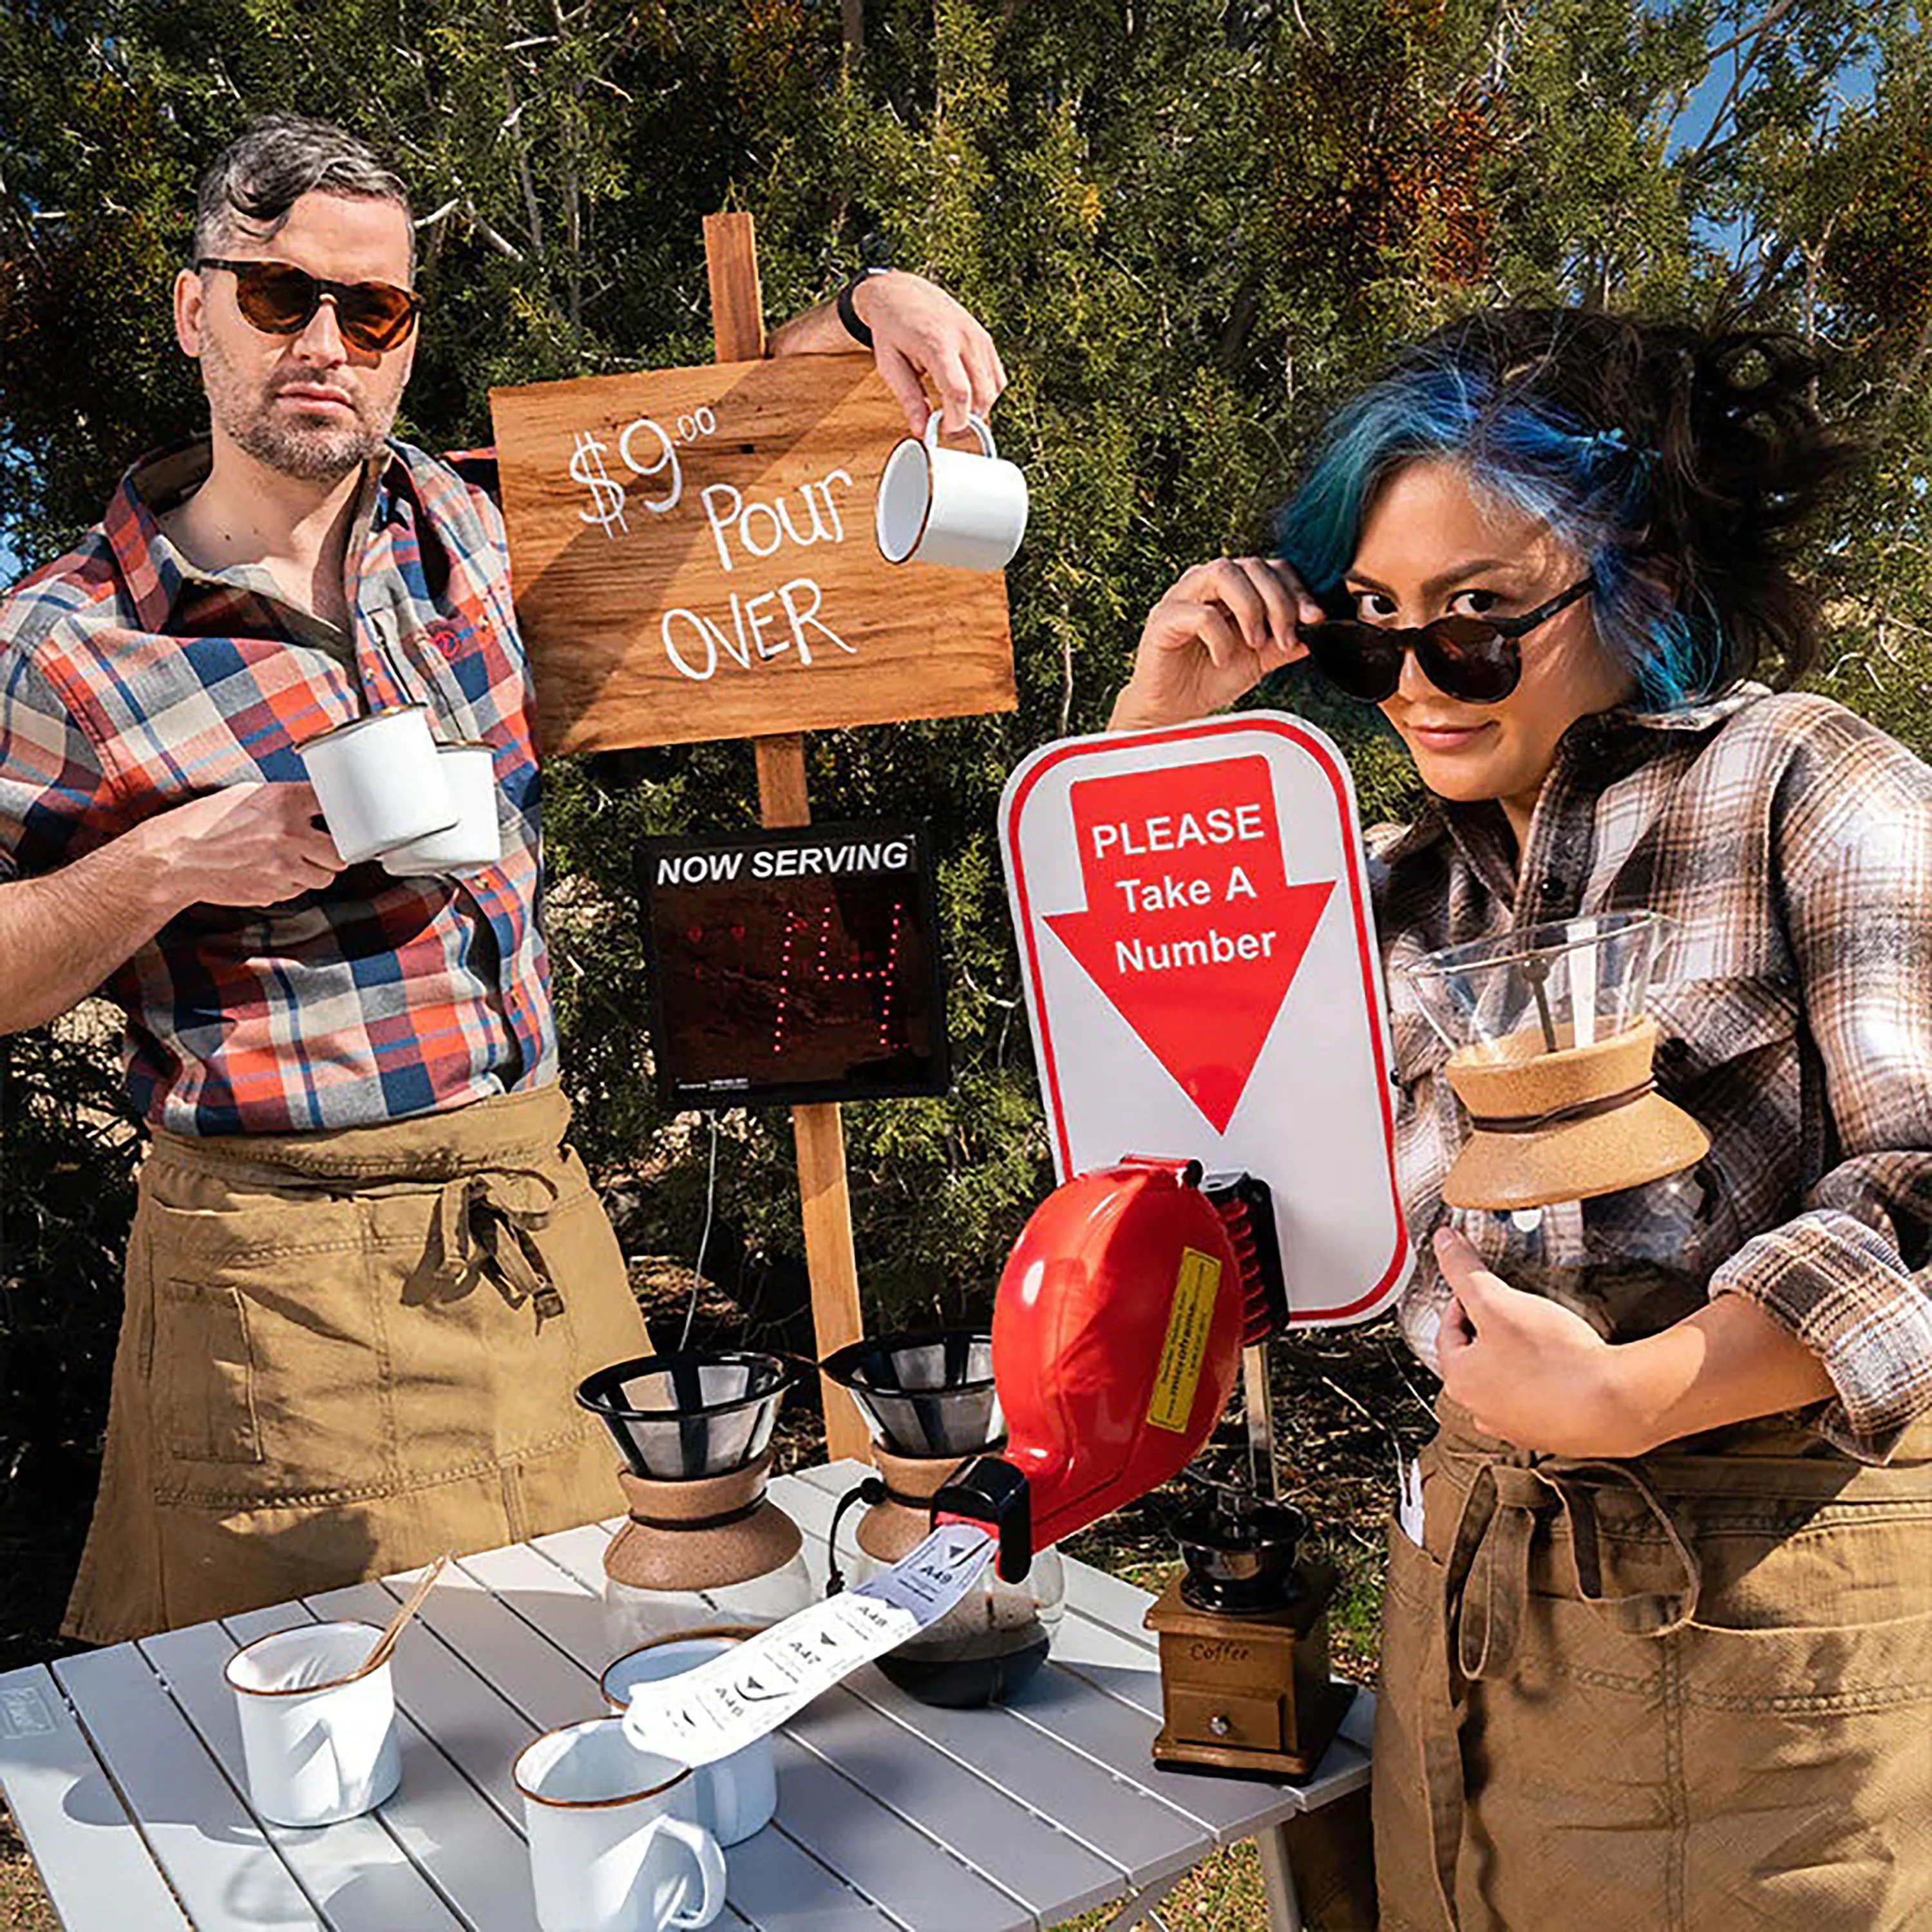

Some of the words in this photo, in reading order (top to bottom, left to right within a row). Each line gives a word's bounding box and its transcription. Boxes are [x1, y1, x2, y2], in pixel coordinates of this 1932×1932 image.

[569, 406, 716, 538] $9.00
[701, 469, 854, 572] Pour
[661, 578, 858, 681] OVER
[1092, 803, 1265, 859] PLEASE
[657, 852, 744, 886] NOW
[752, 842, 909, 878] SERVING
[1115, 875, 1211, 913] Take
[1226, 866, 1256, 901] A
[774, 904, 901, 1052] 14
[1115, 929, 1277, 974] Number
[1191, 1640, 1249, 1662] Coffee
